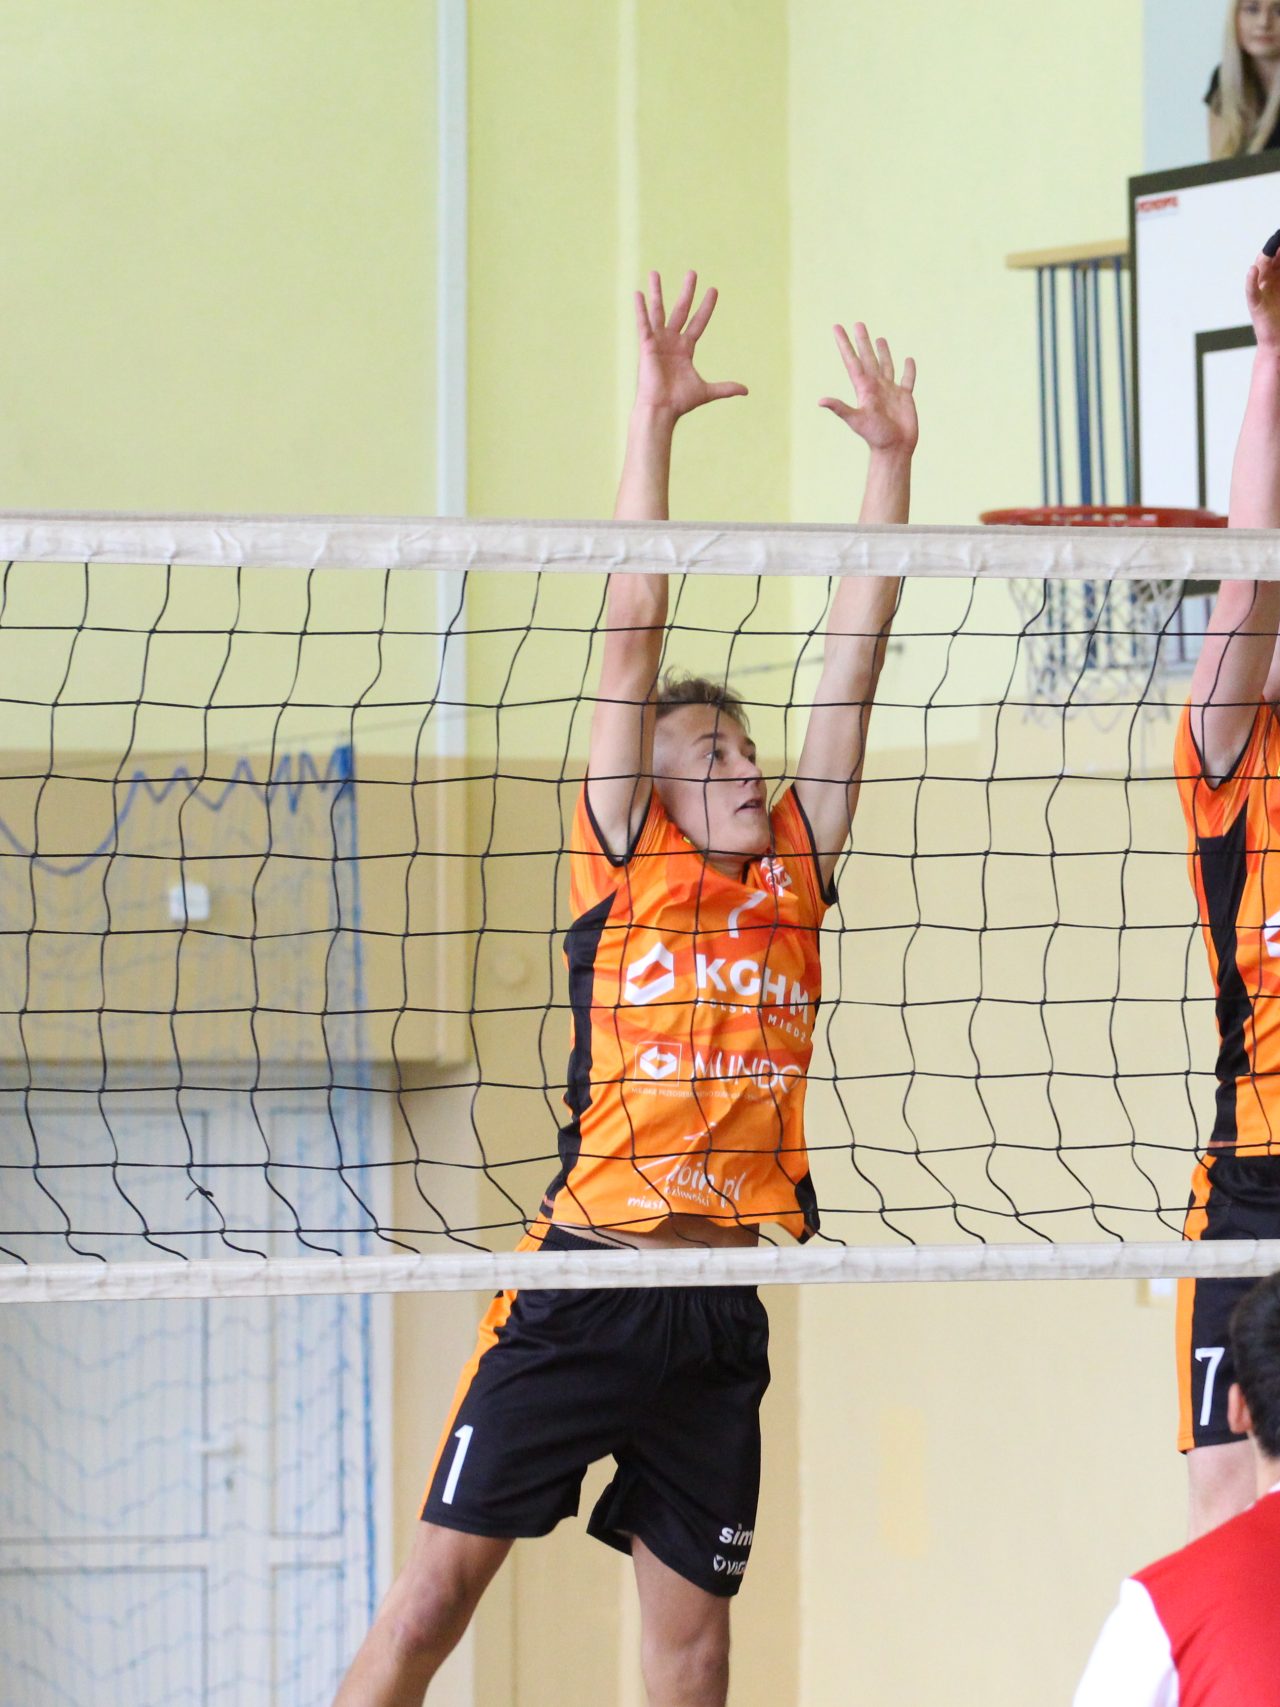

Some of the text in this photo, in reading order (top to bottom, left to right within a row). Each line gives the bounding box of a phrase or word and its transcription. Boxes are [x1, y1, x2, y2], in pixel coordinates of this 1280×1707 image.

[696, 954, 809, 1025] KGHM
[690, 1050, 802, 1094] MUNDO
[627, 1196, 664, 1209] miast
[1195, 1347, 1225, 1426] 7
[442, 1424, 474, 1505] 1
